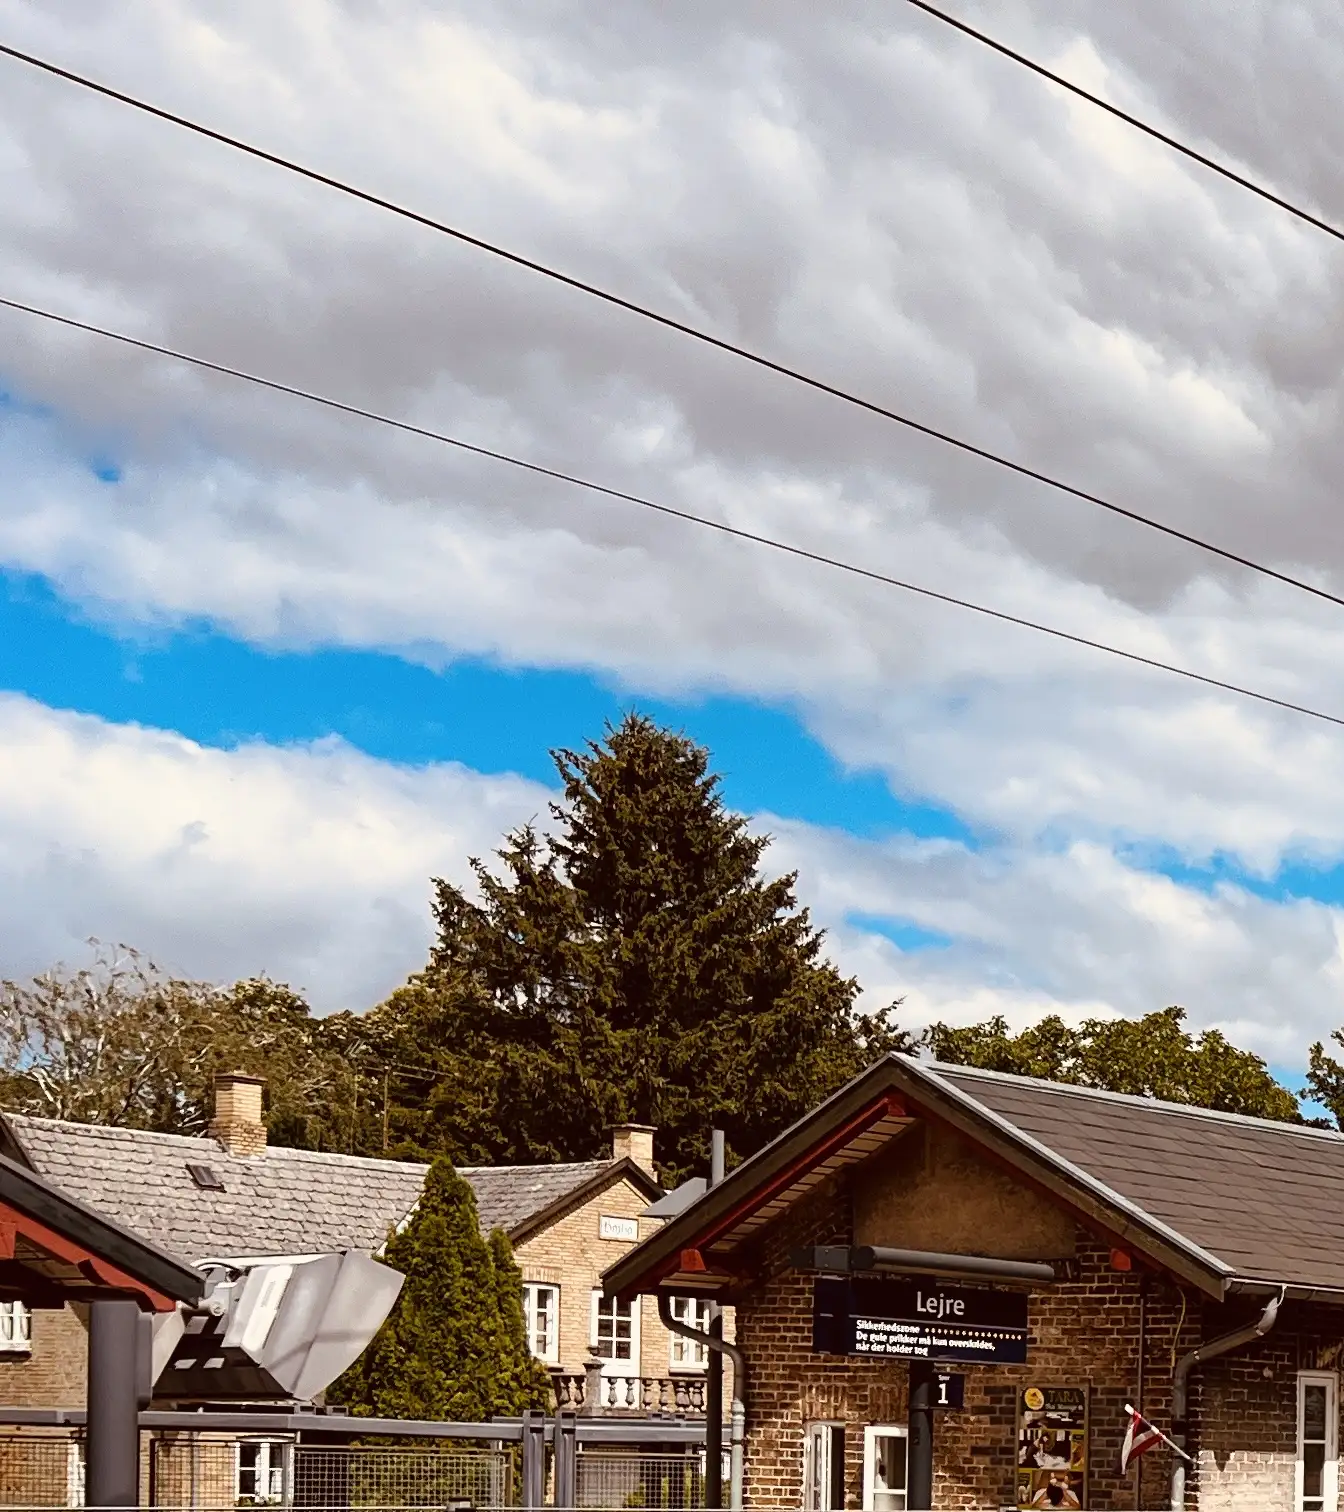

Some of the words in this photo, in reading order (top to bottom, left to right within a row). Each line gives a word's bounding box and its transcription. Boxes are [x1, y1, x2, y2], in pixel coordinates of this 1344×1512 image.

[917, 1291, 965, 1318] Lejre
[856, 1319, 920, 1333] Sikkerhedszone
[856, 1330, 868, 1341] De
[869, 1332, 888, 1343] gule
[889, 1333, 918, 1344] prikker
[918, 1335, 932, 1345] må
[932, 1336, 948, 1346] kun
[855, 1340, 870, 1351] når
[870, 1342, 886, 1352] der
[886, 1343, 914, 1354] holder
[914, 1346, 929, 1357] tog
[938, 1383, 949, 1405] 1
[1048, 1390, 1080, 1403] TARA
